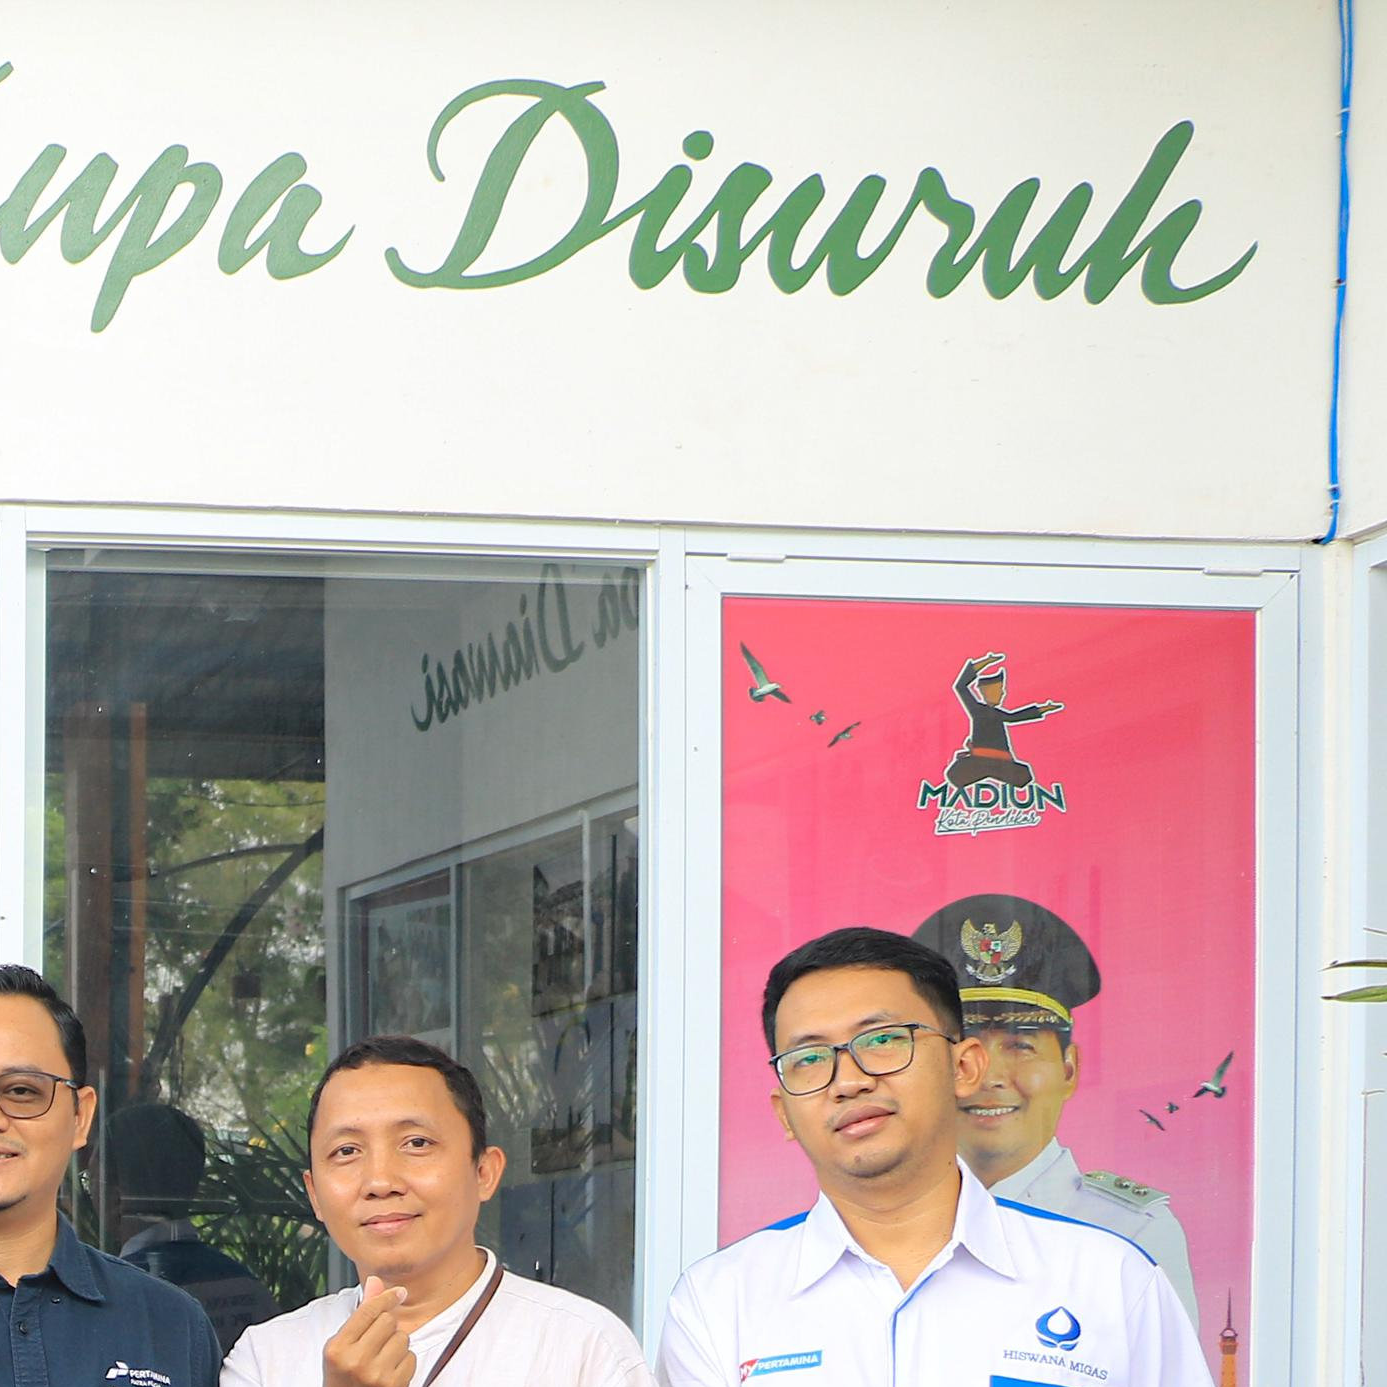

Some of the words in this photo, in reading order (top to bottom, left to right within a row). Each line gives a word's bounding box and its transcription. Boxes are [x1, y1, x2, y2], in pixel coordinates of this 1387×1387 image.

[384, 77, 1259, 307] Disuruh
[919, 782, 1065, 813] MADIUN
[1002, 1349, 1067, 1367] HISWANA
[1069, 1360, 1109, 1380] MIGAS
